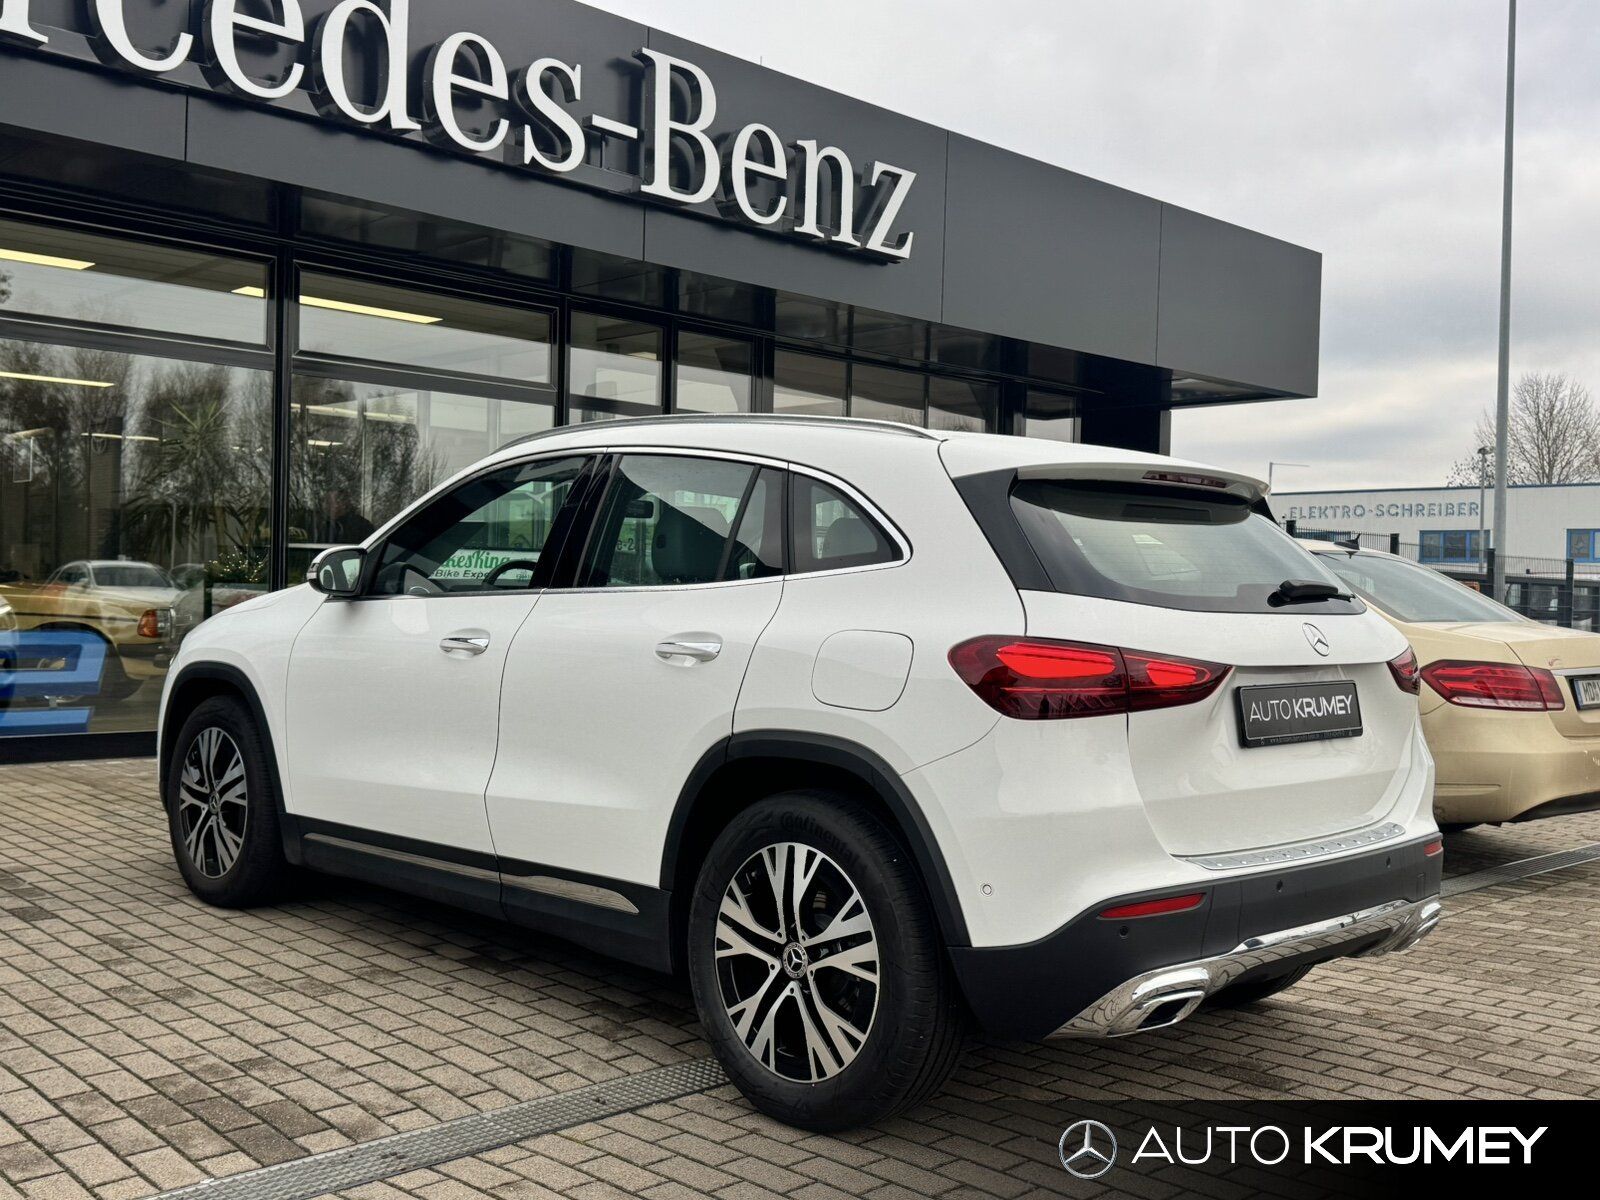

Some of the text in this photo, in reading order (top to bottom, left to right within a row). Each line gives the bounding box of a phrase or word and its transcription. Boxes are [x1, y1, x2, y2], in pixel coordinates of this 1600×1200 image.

[0, 0, 917, 259] cedes-Benz
[1249, 694, 1353, 722] AUTO KRUMEY
